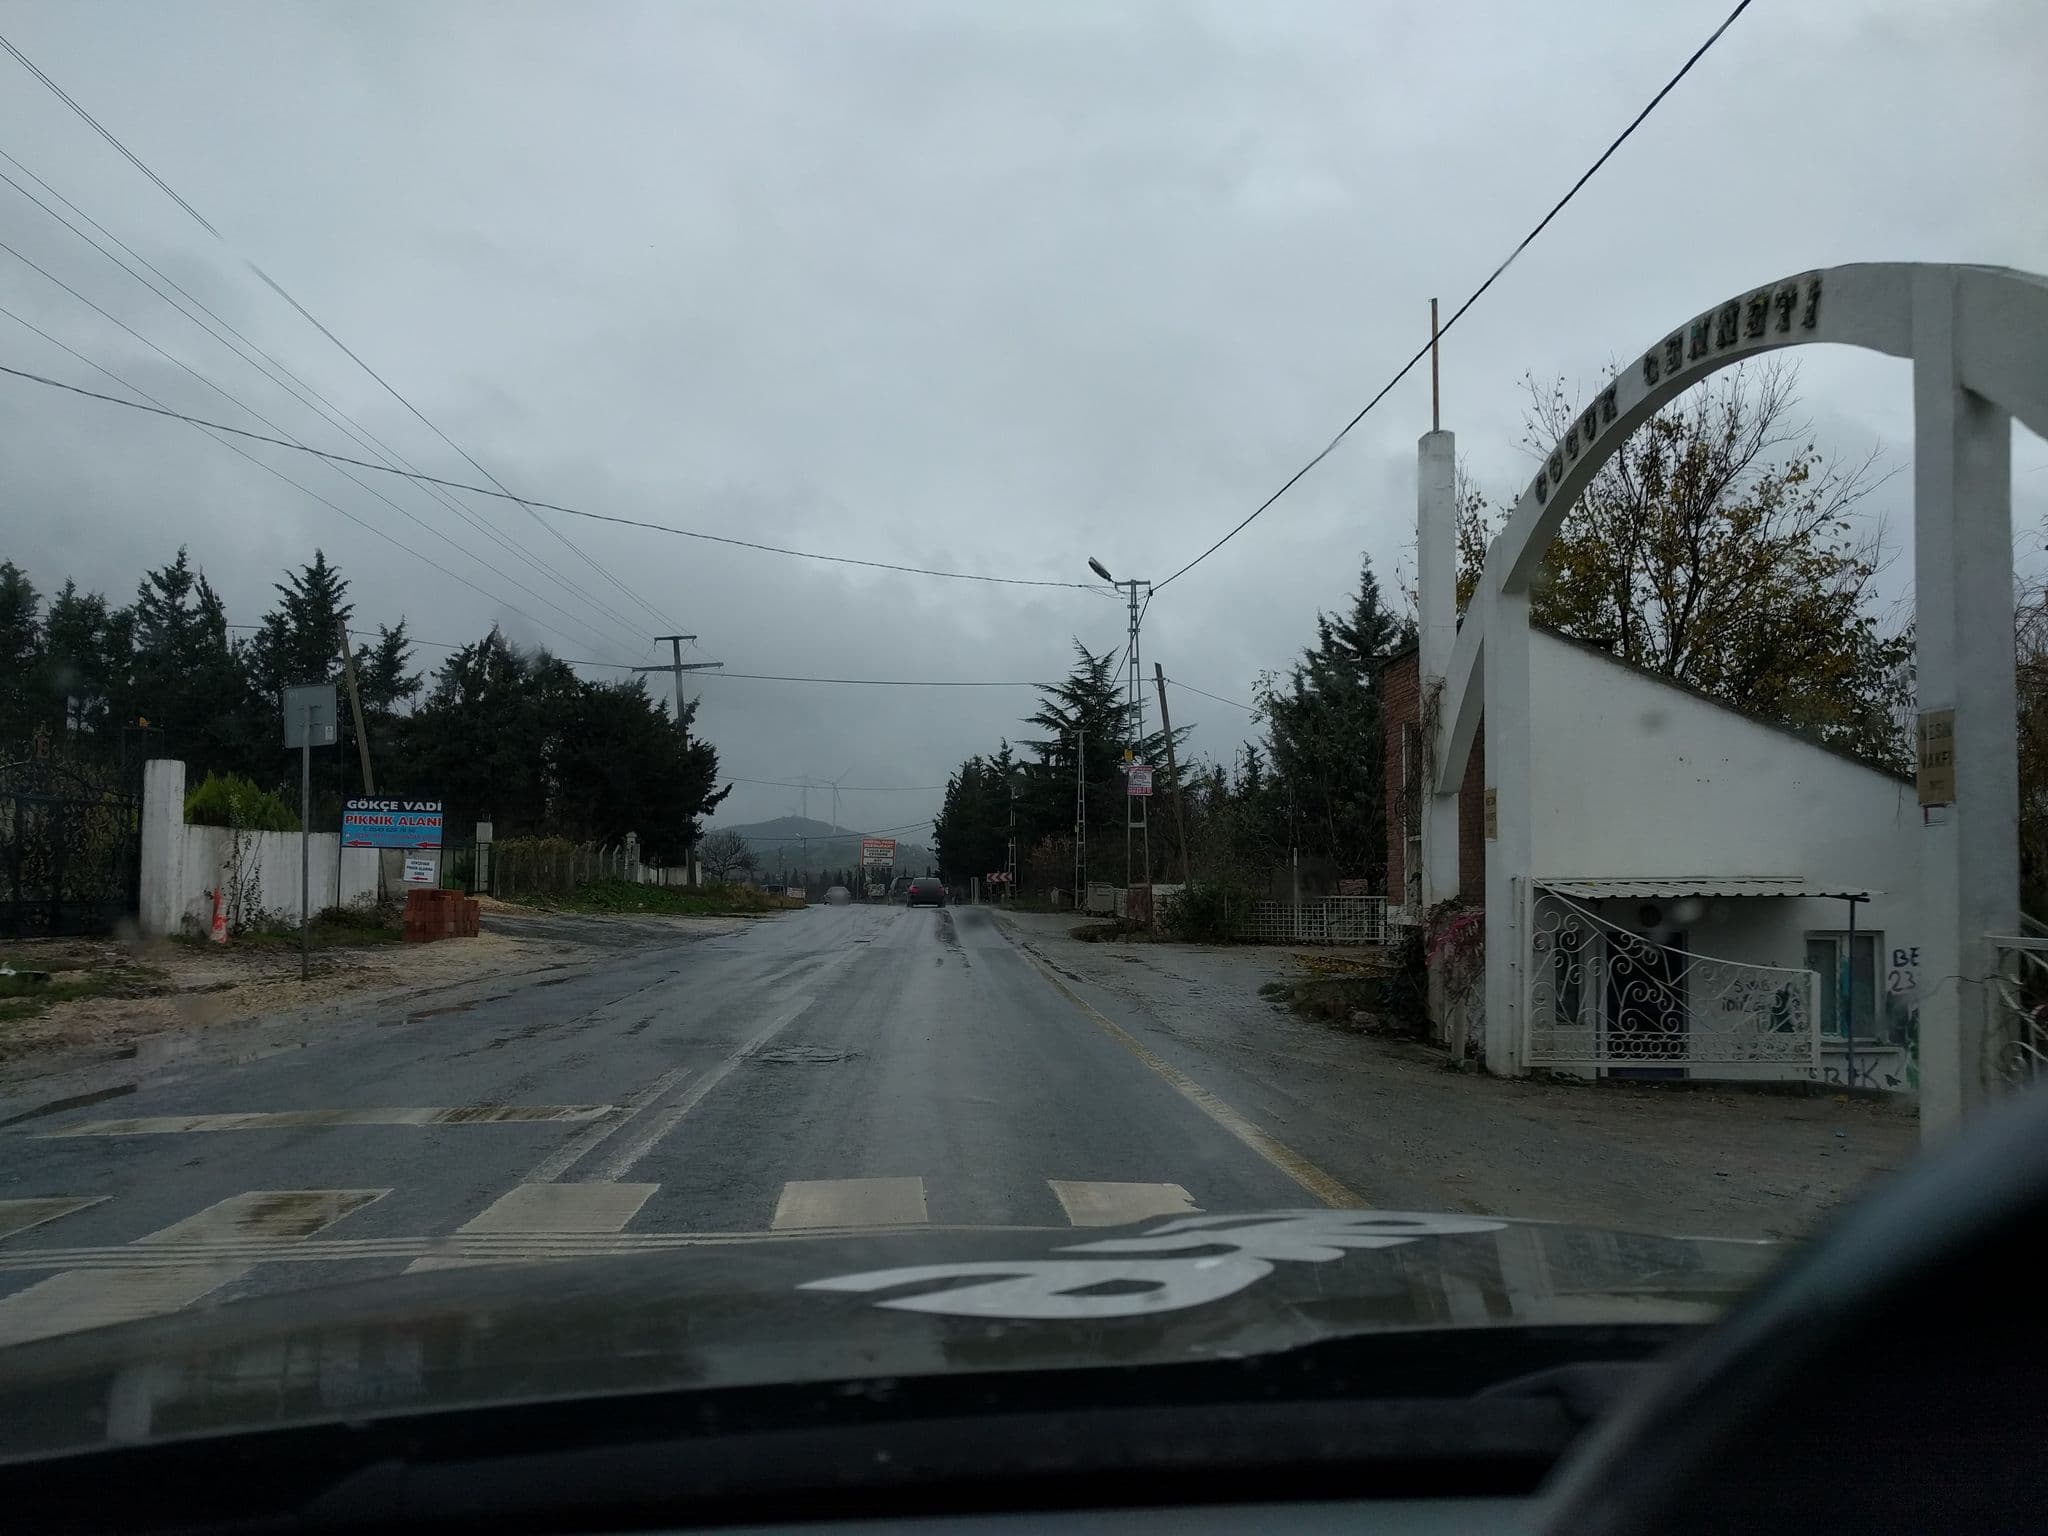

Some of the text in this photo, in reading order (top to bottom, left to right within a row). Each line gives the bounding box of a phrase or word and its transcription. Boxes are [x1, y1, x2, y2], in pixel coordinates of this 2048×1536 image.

[347, 798, 442, 812] GÖKÇE VADİ
[398, 816, 442, 827] ALANI
